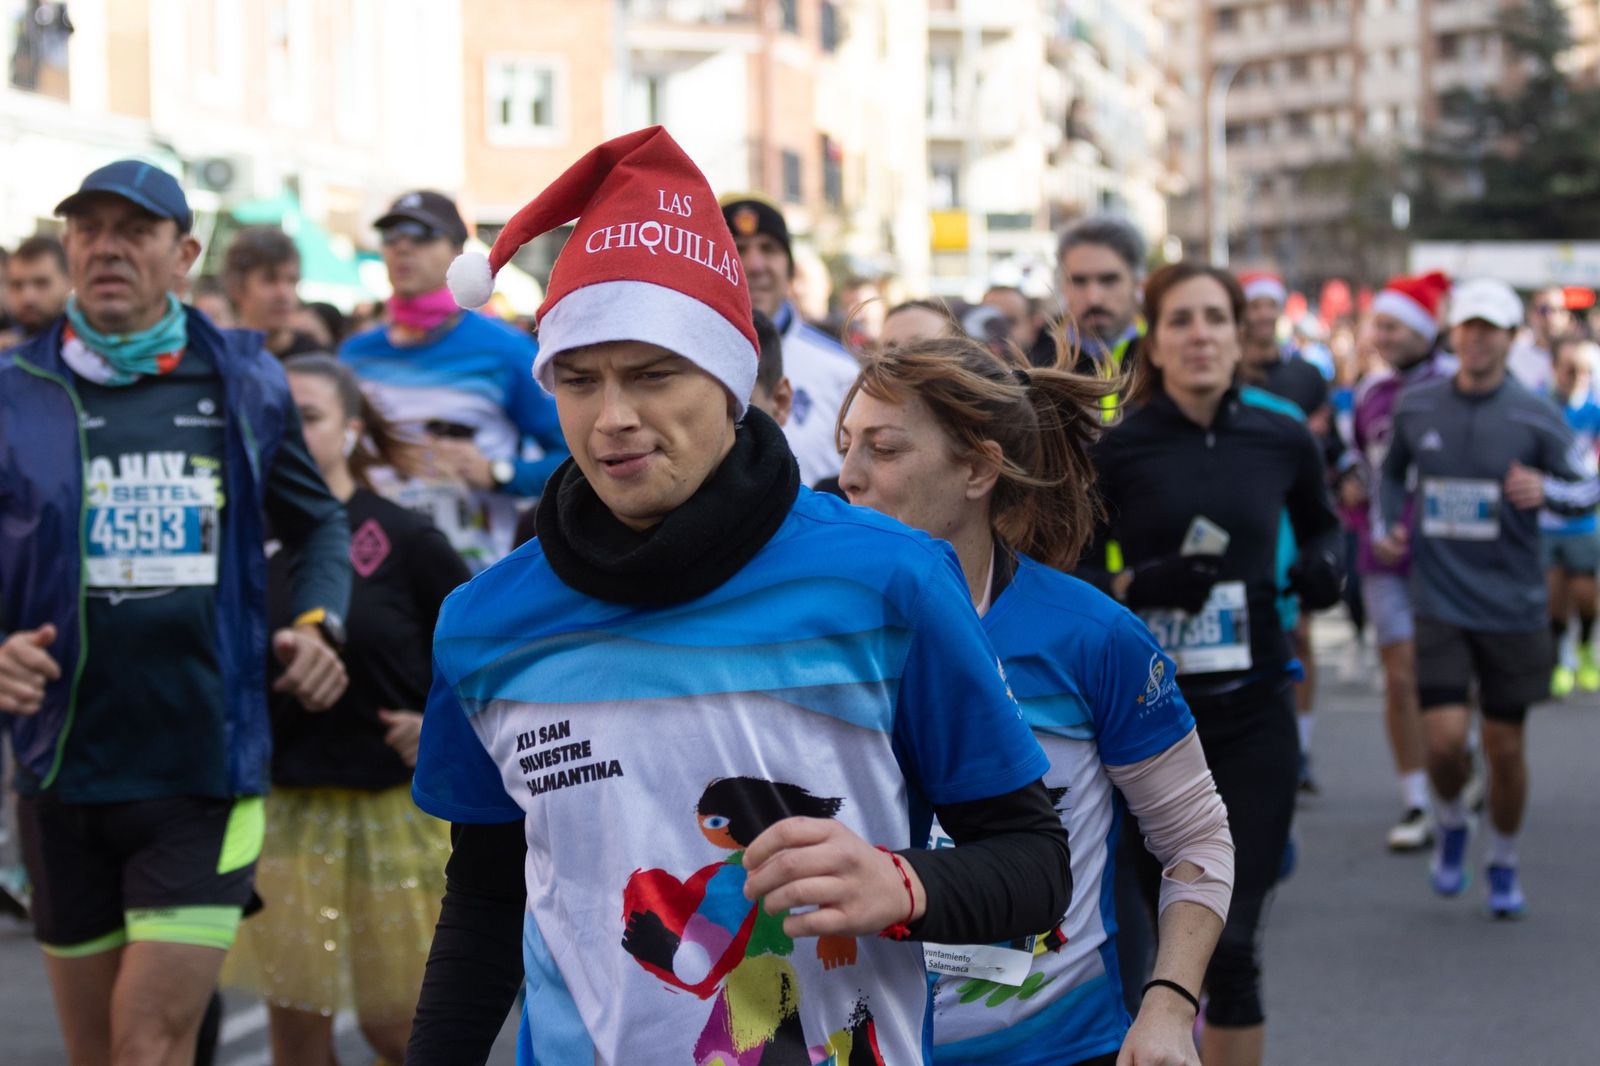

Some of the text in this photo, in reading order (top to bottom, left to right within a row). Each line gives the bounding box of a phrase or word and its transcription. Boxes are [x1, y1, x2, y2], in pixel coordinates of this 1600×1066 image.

[657, 189, 692, 218] LAS
[585, 220, 740, 287] CHIQUILLAS
[90, 508, 184, 549] 4593
[1149, 607, 1222, 646] 5736
[539, 720, 571, 745] SAN
[519, 740, 592, 775] SILVESTRE
[526, 759, 624, 797] SALMANTINA
[924, 949, 971, 963] yuntamiento
[928, 960, 969, 973] Salamanca
